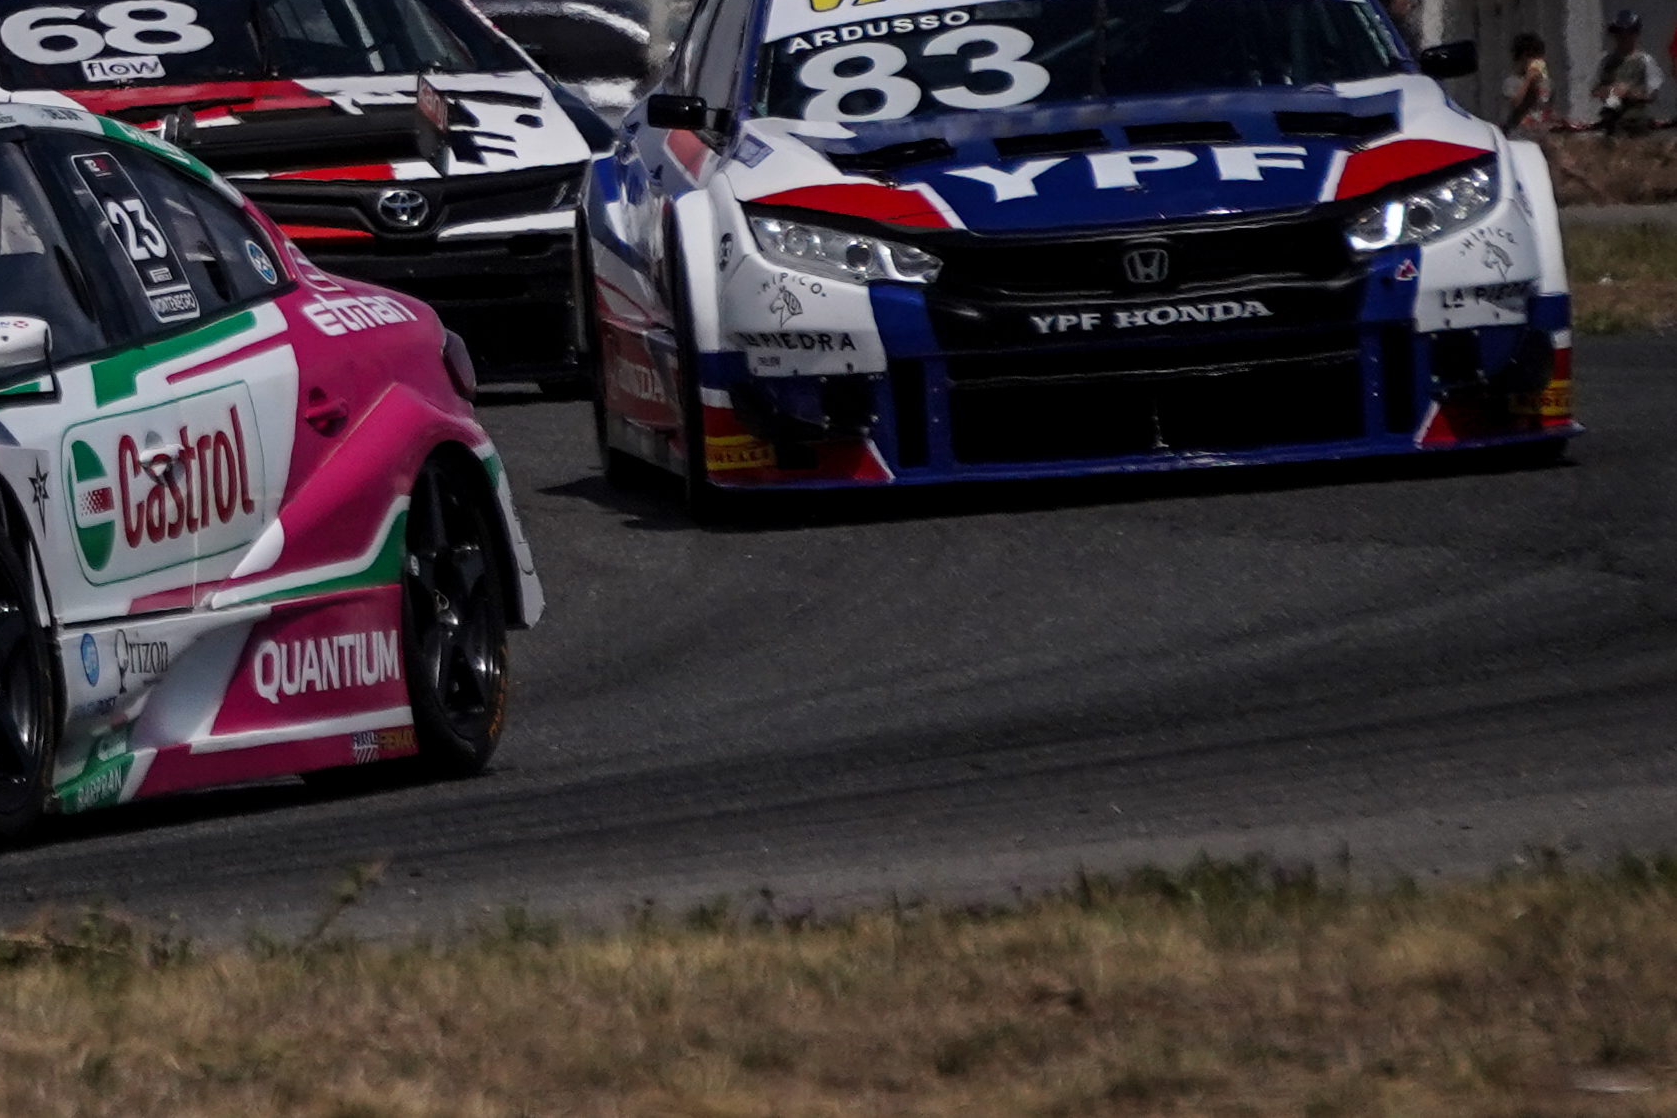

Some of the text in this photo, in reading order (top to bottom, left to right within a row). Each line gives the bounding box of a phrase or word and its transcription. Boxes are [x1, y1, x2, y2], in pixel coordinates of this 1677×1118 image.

[0, 0, 215, 65] 68
[788, 10, 971, 55] ARDUSSO
[86, 59, 160, 81] flow
[800, 24, 1051, 123] 83
[946, 145, 1309, 203] YPF
[107, 198, 167, 261] 23
[1029, 300, 1274, 334] YPF HONDA
[119, 405, 255, 549] Castrol
[254, 630, 401, 704] QUANTIUM
